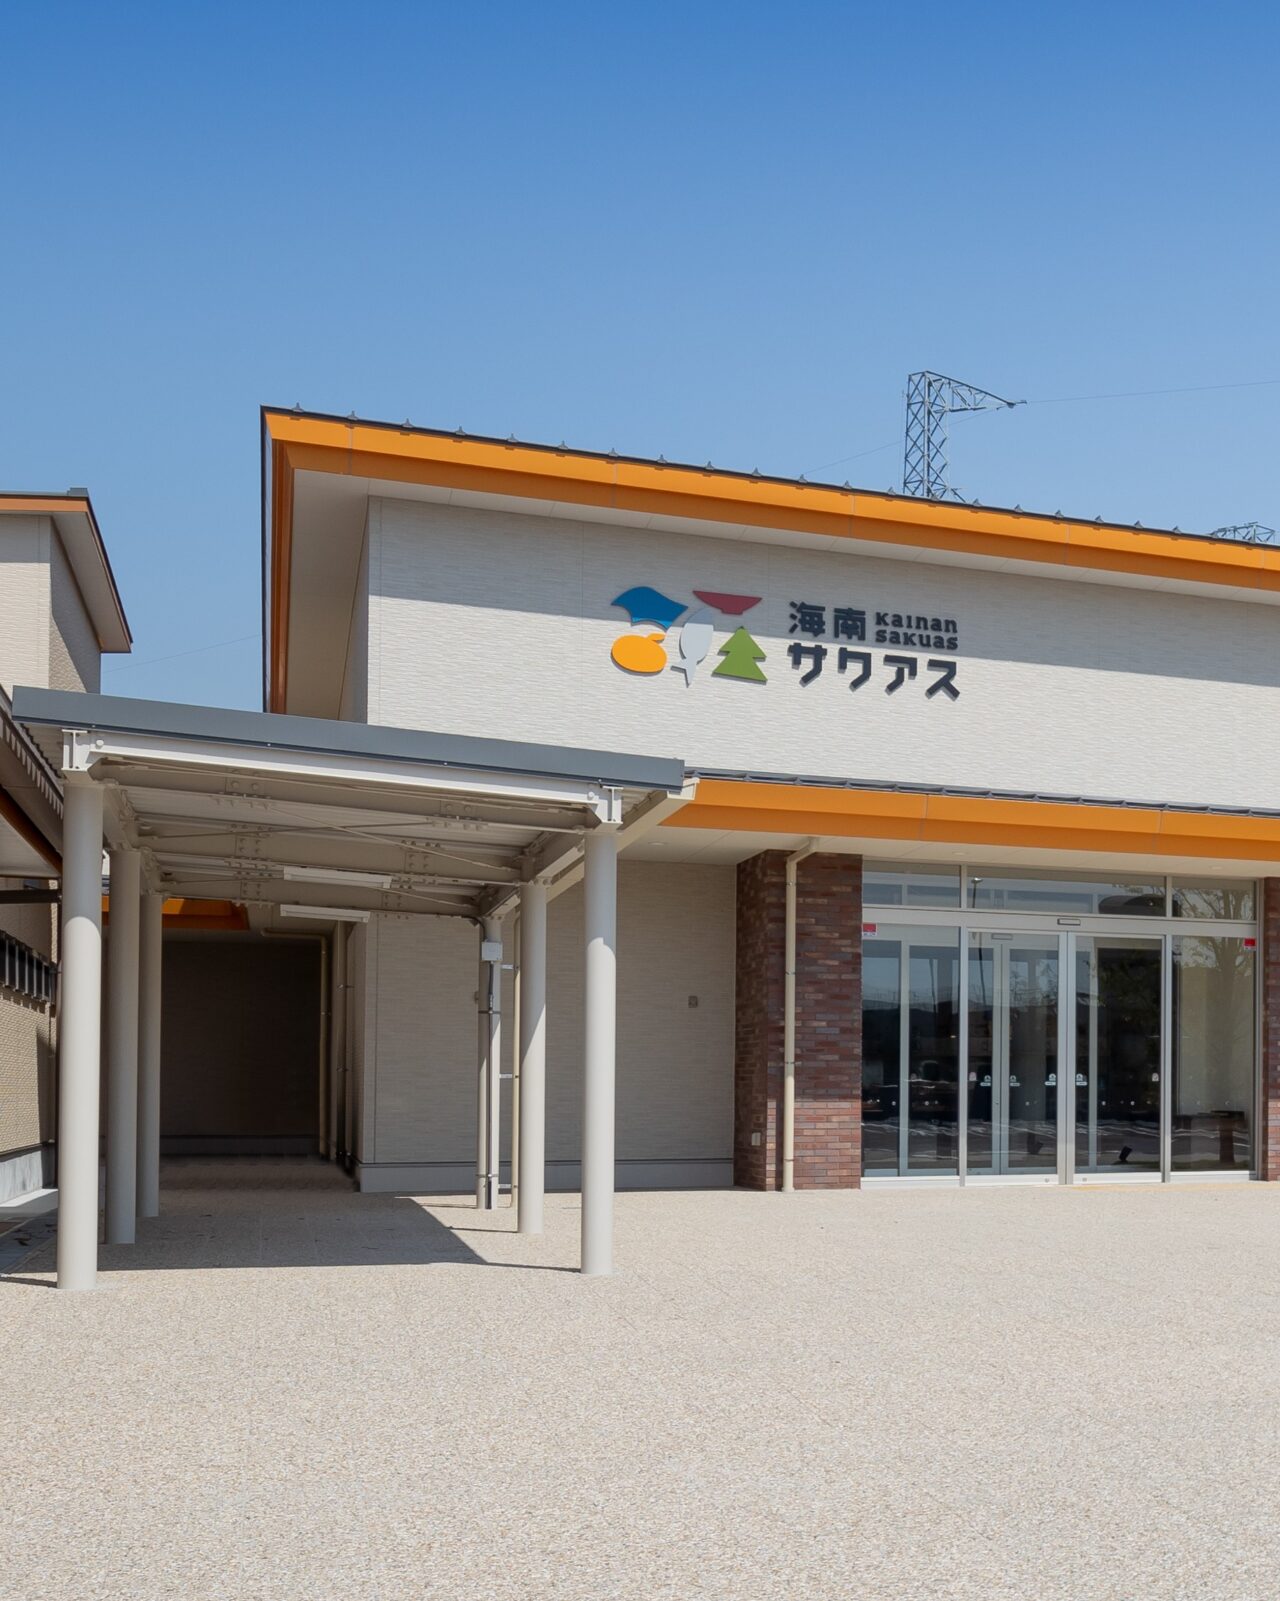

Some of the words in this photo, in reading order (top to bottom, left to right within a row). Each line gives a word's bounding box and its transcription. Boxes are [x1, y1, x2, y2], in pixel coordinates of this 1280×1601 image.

[789, 600, 866, 641] 海南
[787, 643, 960, 701] サクアス
